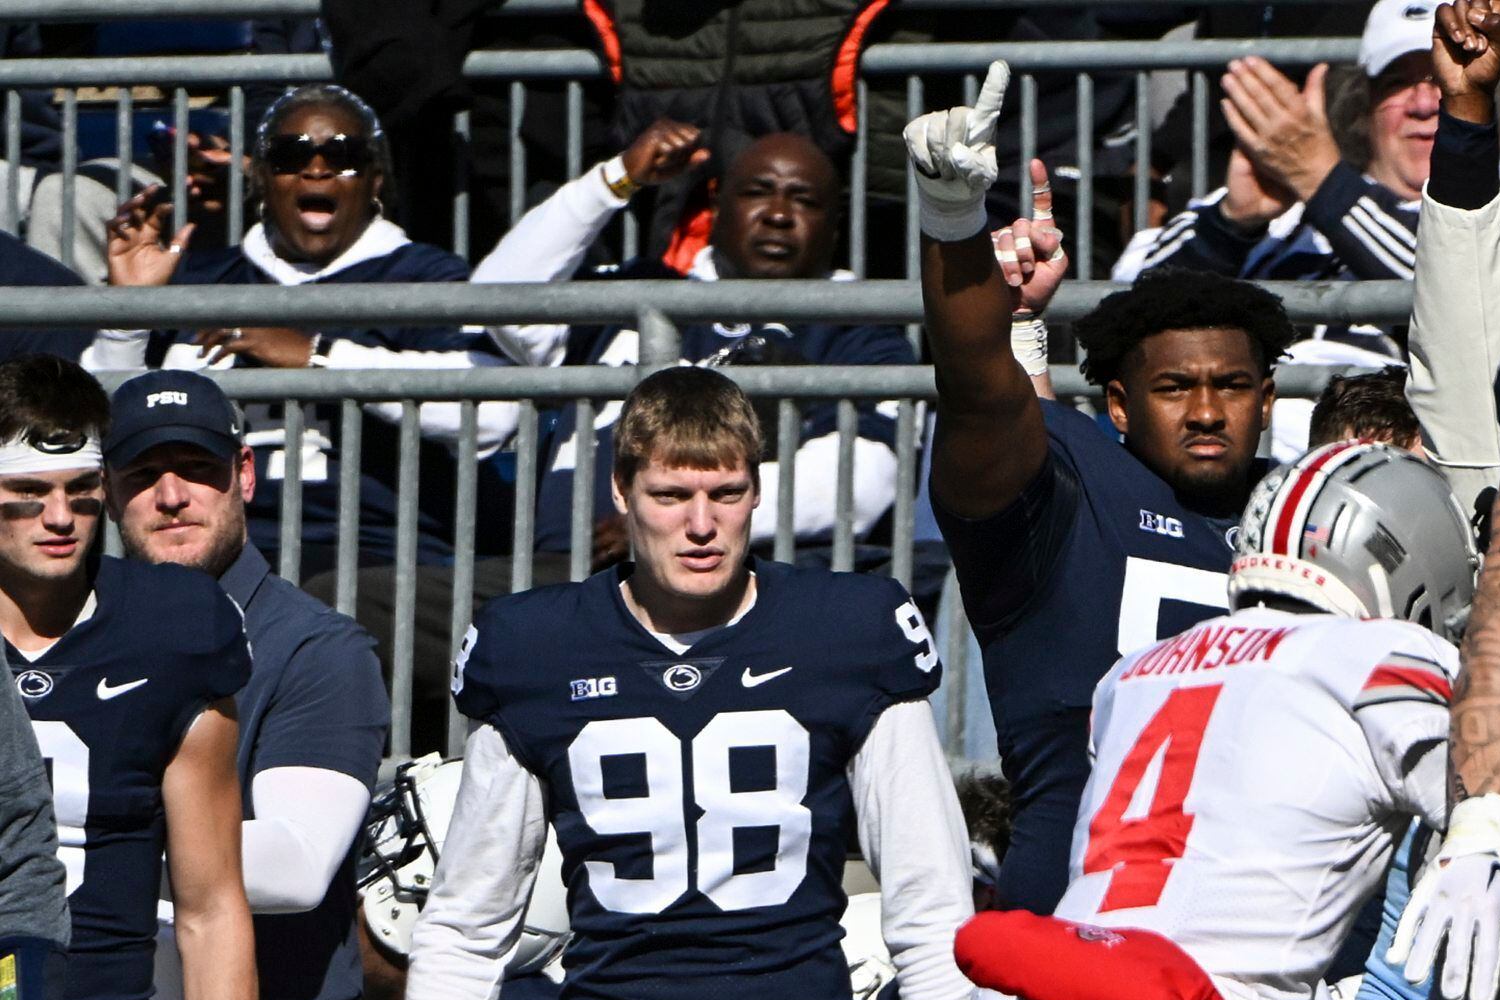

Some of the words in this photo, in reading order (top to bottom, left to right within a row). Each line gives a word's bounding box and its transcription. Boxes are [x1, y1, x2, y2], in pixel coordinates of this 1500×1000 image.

[147, 391, 188, 408] PSU
[1119, 626, 1291, 681] JOHNSON
[568, 709, 811, 914] 98
[1083, 683, 1224, 914] 4
